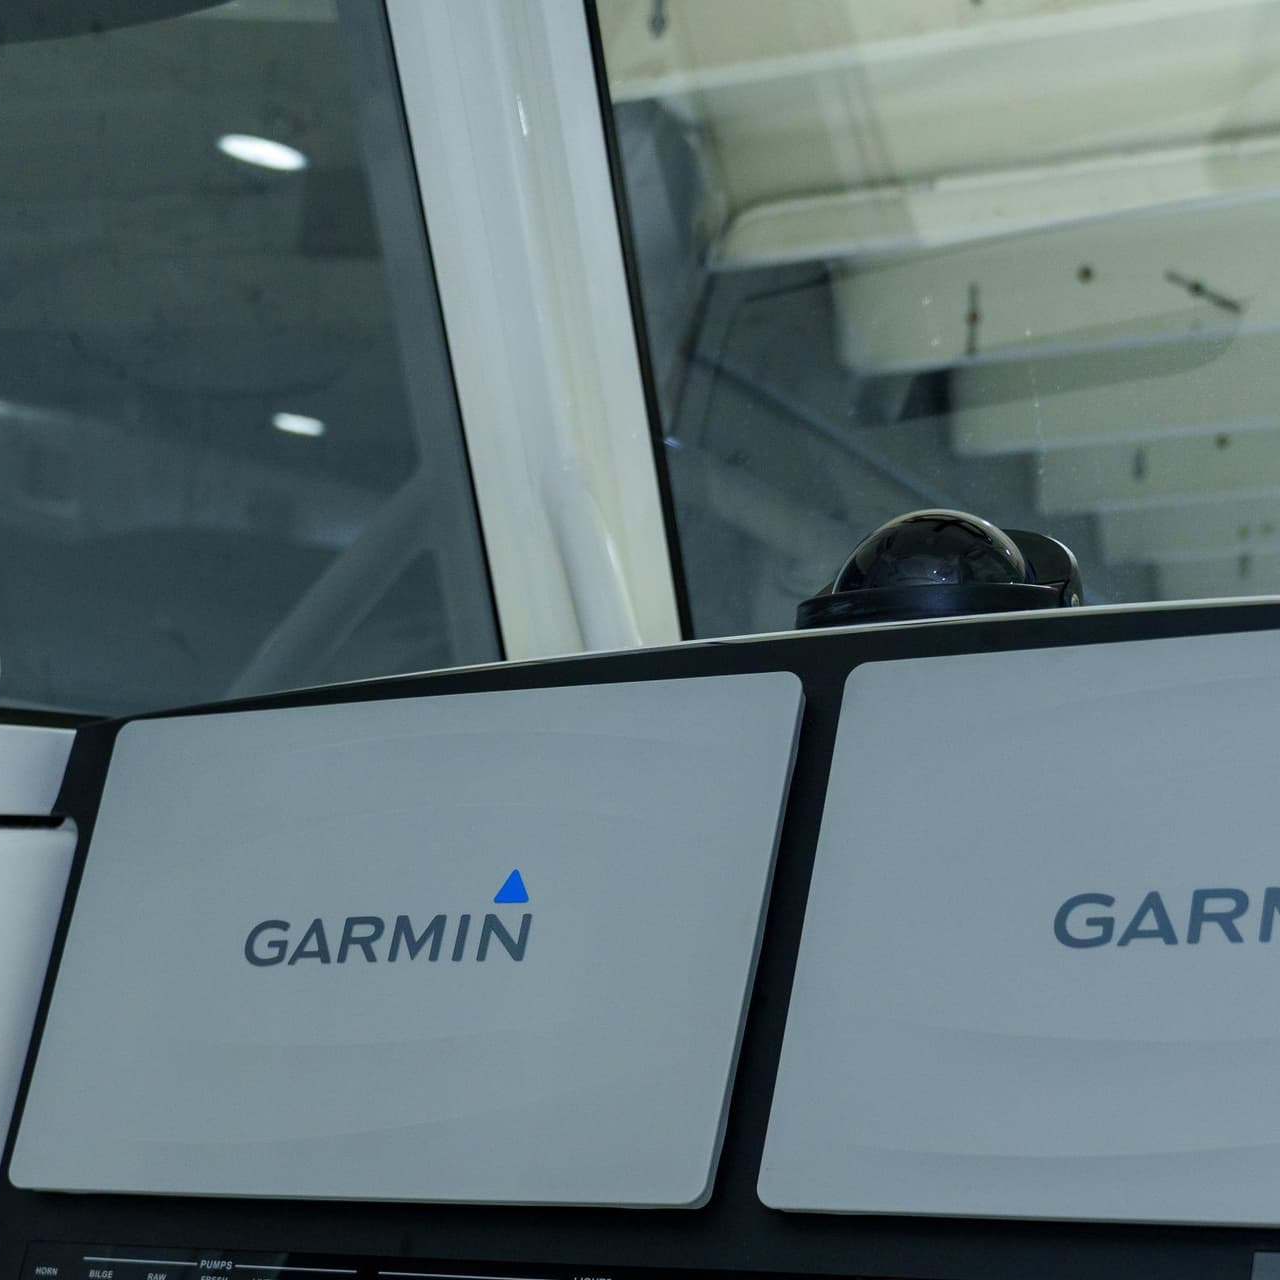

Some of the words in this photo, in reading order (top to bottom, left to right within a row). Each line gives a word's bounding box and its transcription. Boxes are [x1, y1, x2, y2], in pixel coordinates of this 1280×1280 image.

[244, 913, 532, 966] GARMIN
[200, 1260, 232, 1270] PUMPS
[36, 1267, 58, 1276] HORN
[89, 1270, 113, 1278] BILGE
[148, 1273, 166, 1280] RAW
